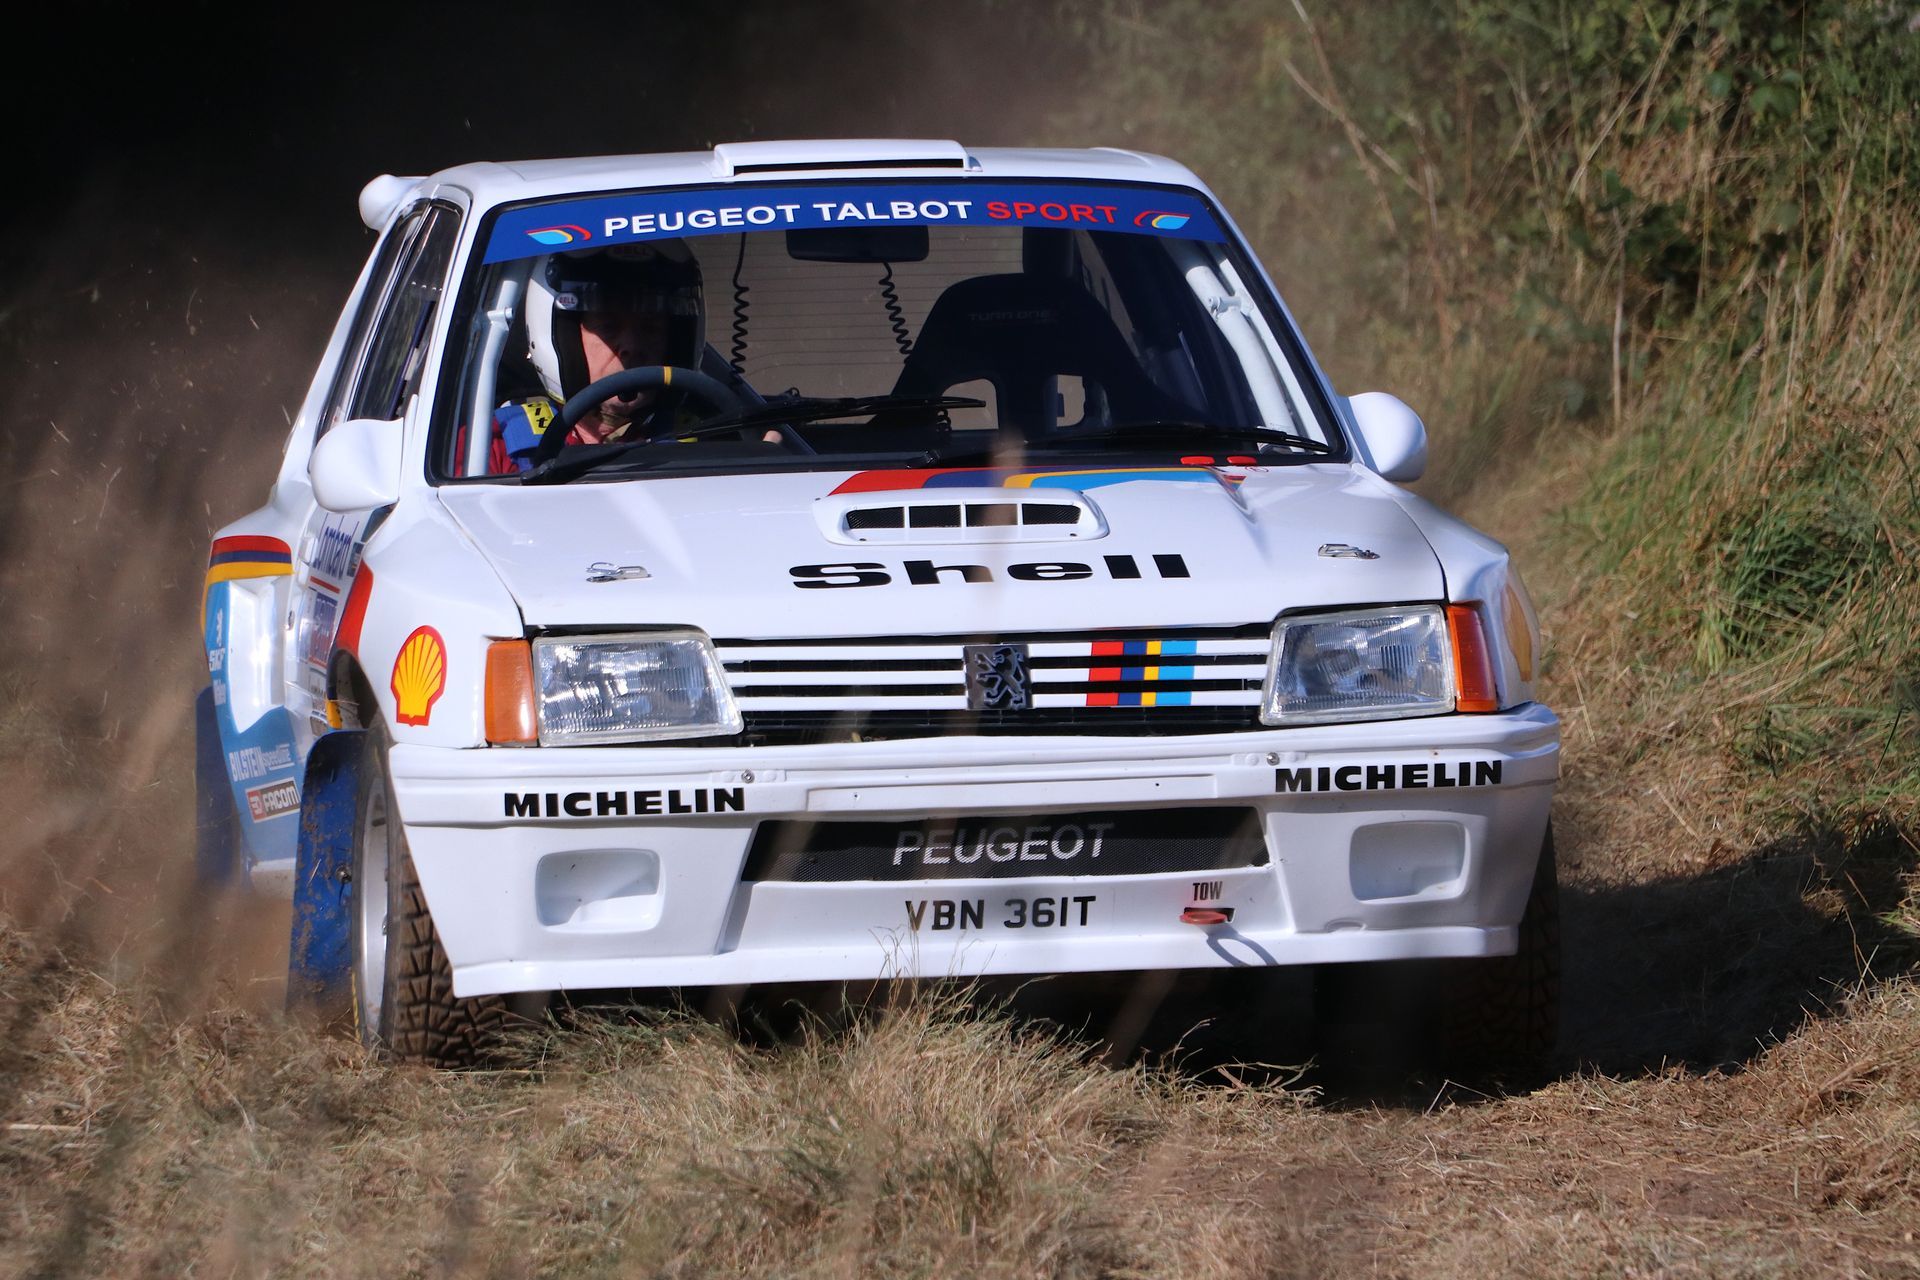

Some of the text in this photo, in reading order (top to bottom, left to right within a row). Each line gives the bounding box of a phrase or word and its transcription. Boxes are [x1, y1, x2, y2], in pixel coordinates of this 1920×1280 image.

[604, 201, 1118, 237] PEUGEOT TALBOT SPORT
[789, 558, 1191, 588] Shell
[1275, 760, 1502, 793] MICHELIN
[262, 786, 299, 812] FACOM
[504, 787, 746, 819] MICHELIN
[893, 823, 1114, 865] PEUGEOT
[1192, 881, 1223, 902] TOW
[905, 896, 1097, 931] VBN 361T
